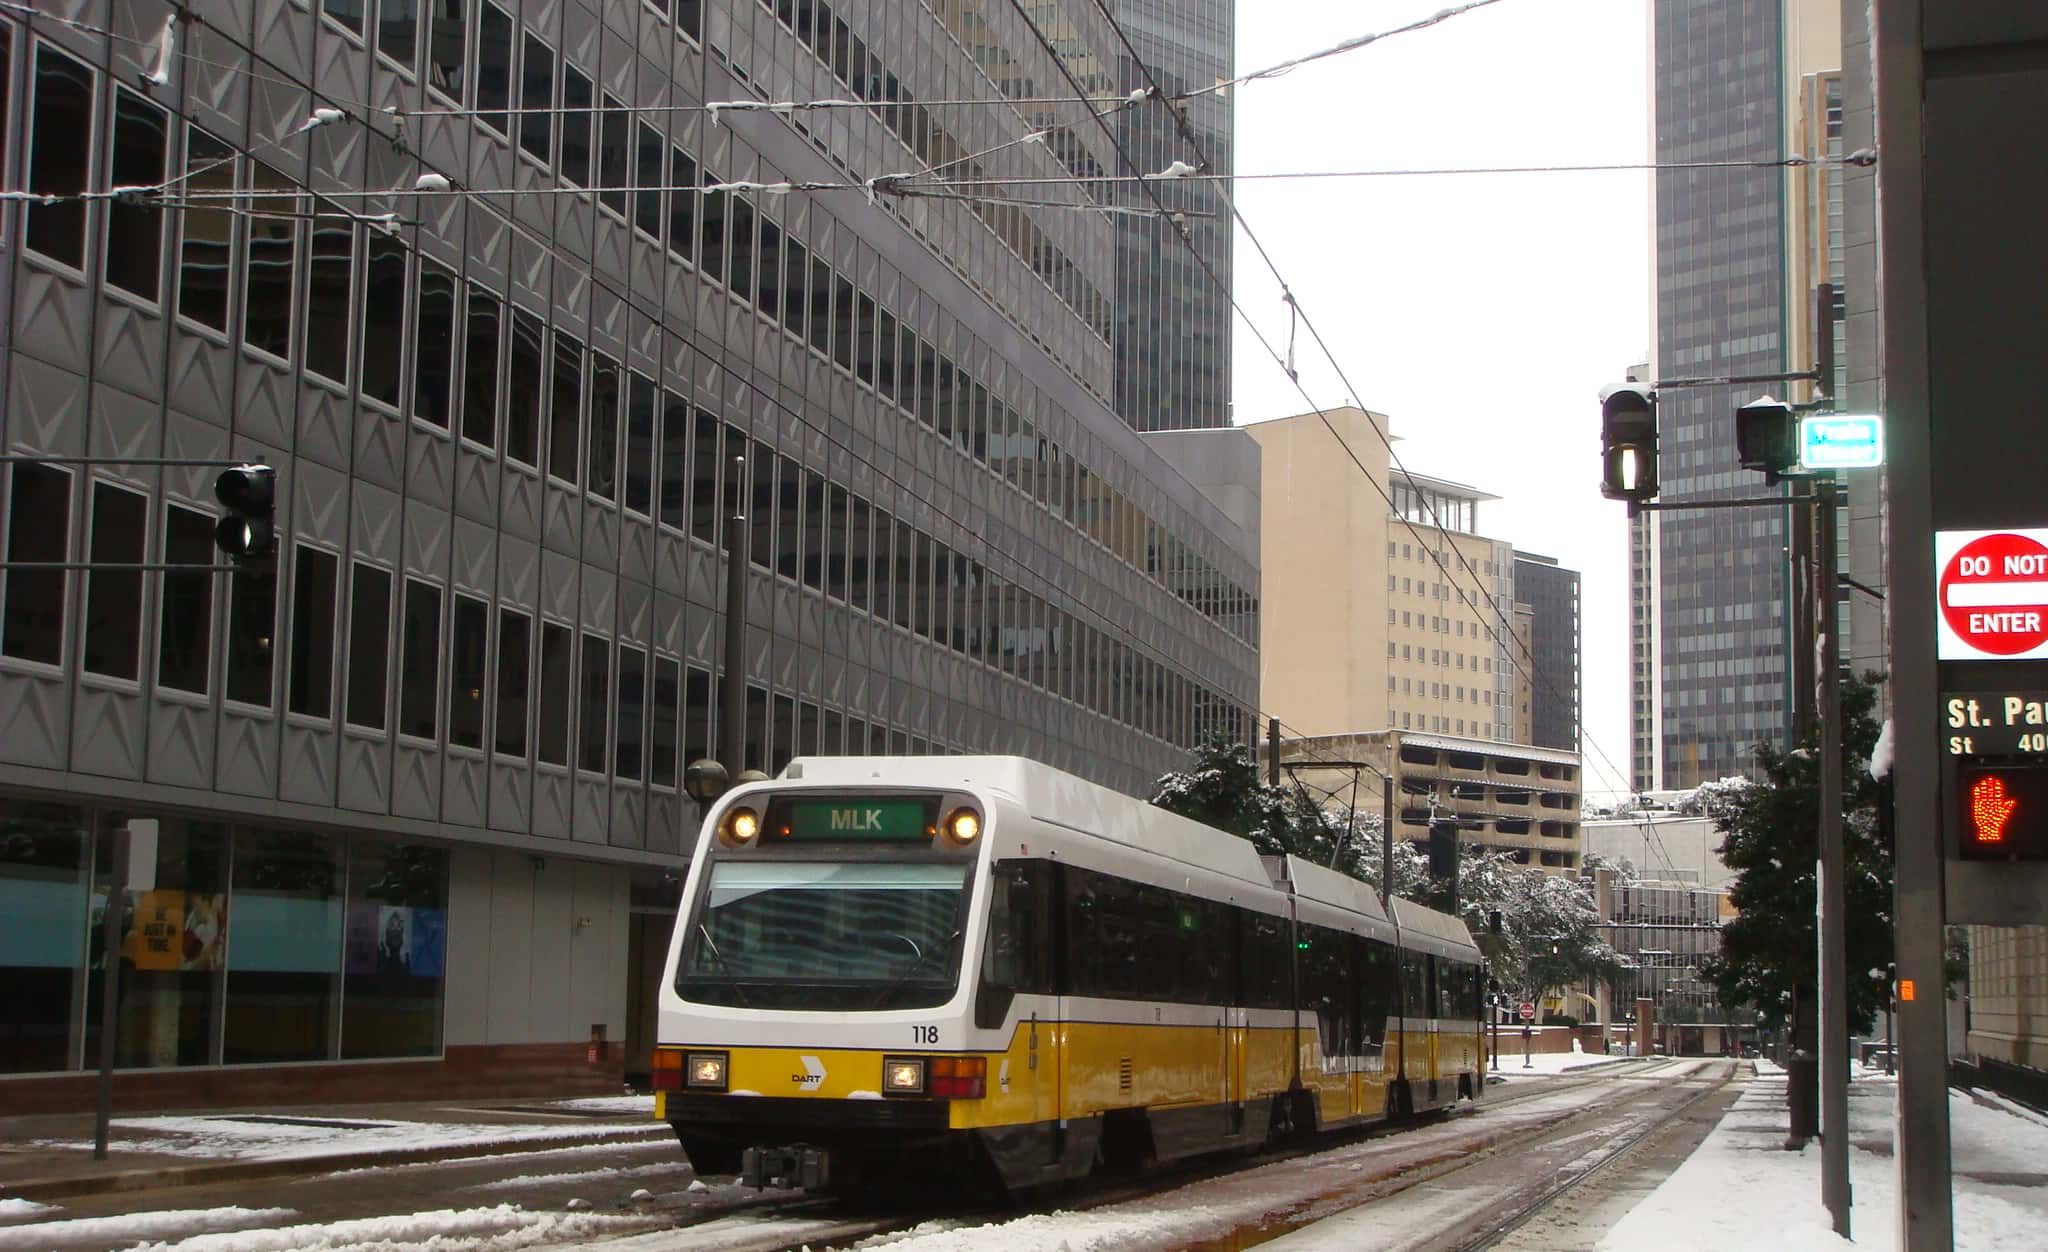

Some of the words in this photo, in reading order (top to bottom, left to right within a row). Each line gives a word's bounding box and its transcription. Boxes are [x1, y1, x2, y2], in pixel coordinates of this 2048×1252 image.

[1960, 555, 1990, 577] DO
[2003, 554, 2048, 576] NOT
[1969, 611, 2041, 634] ENTER
[1947, 698, 1992, 729] St.
[1949, 736, 1974, 755] St
[2018, 733, 2048, 753] 40
[831, 808, 883, 831] MLK
[912, 1025, 939, 1044] 118
[791, 1074, 822, 1083] DART
